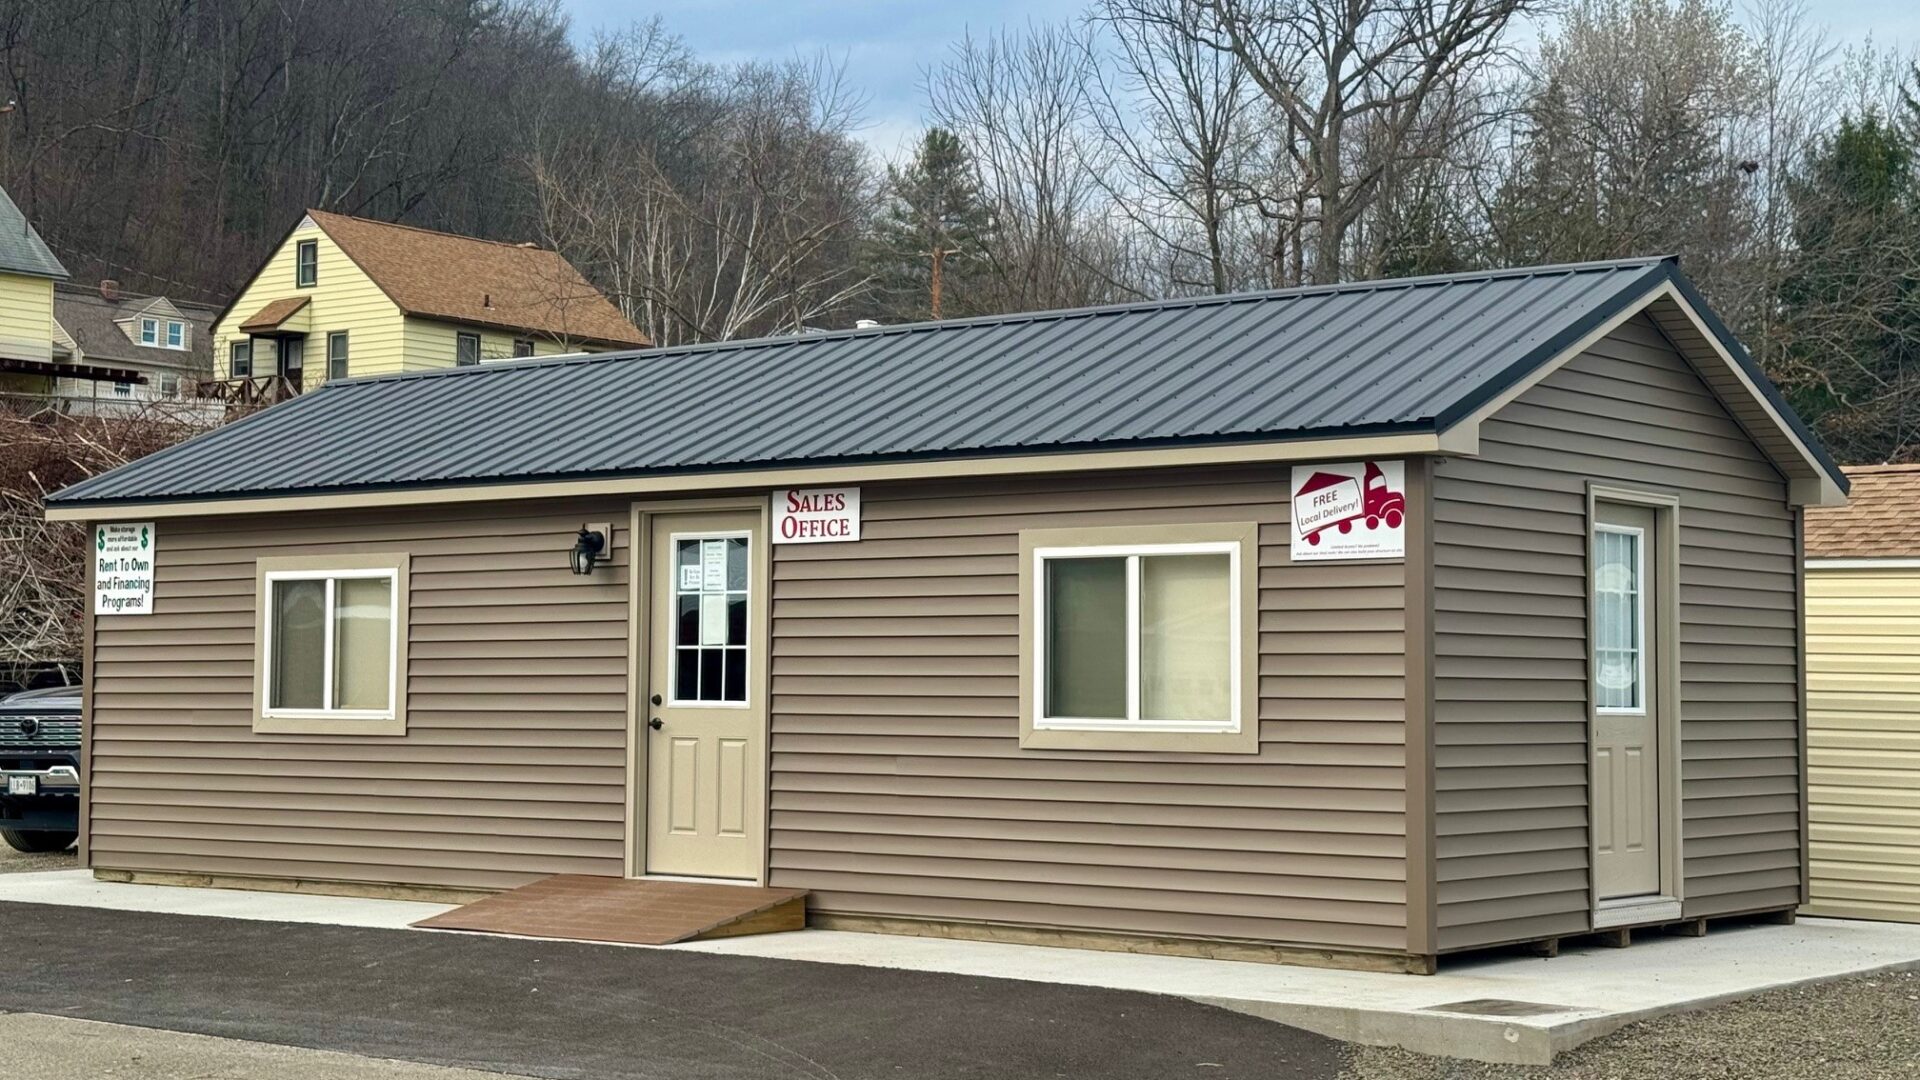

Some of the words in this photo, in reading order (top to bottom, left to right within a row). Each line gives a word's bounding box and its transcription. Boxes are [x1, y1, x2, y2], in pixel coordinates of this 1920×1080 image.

[787, 489, 845, 513] SALES
[1313, 490, 1338, 508] FREE
[1300, 513, 1321, 526] Local
[1323, 498, 1359, 519] Delivery!
[781, 516, 850, 539] OFFICE
[99, 558, 117, 572] Rent
[120, 558, 129, 571] To
[131, 557, 149, 571] Own
[97, 576, 112, 590] and
[113, 576, 150, 594] Financing
[102, 593, 144, 612] Programs!
